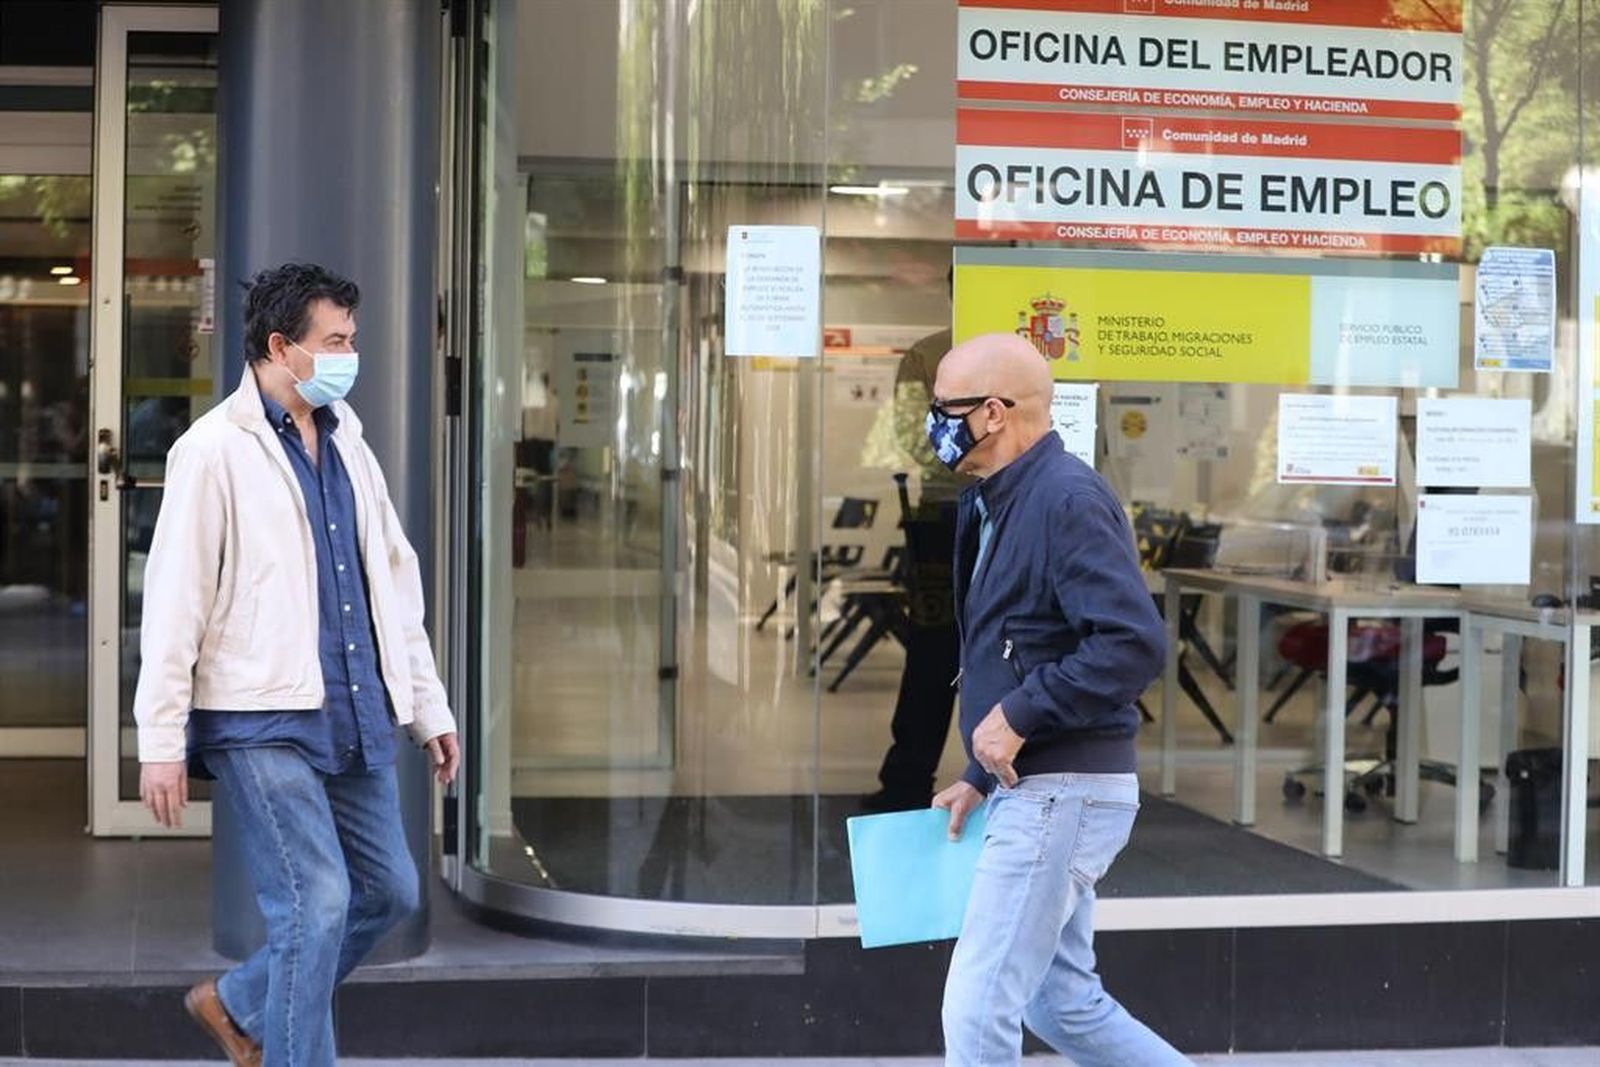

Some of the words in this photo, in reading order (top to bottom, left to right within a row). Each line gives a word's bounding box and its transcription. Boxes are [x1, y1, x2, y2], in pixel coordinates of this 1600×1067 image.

[1243, 0, 1260, 9] de
[1263, 0, 1308, 12] Madrid
[969, 29, 1126, 66] OFICINA
[1139, 37, 1211, 70] DEL
[1224, 41, 1453, 83] EMPLEADOR
[1059, 88, 1140, 104] CONSEJERÍA
[1143, 92, 1160, 104] DE
[1164, 93, 1235, 109] ECONOMÍA,
[1239, 96, 1291, 110] EMPLEO
[1294, 99, 1304, 110] Y
[1305, 99, 1369, 113] HACIENDA
[1162, 129, 1238, 143] Comunidad
[1241, 133, 1258, 144] de
[1262, 134, 1308, 146] Madrid
[967, 163, 1166, 208] OFICINA
[1182, 171, 1243, 211] DE
[1261, 174, 1451, 219] EMPLEO
[1057, 225, 1138, 241] CONSEJERÍA
[1141, 229, 1159, 241] DE
[1236, 232, 1289, 245] EMPLEO
[1291, 234, 1301, 245] Y
[1302, 234, 1367, 248] HACIENDA
[1097, 315, 1165, 329] MINISTERIO
[1097, 329, 1113, 341] DE
[1171, 331, 1253, 345] MIGRACIONES
[1354, 335, 1390, 345] EMPLEO
[1392, 335, 1429, 346] ESTATAL
[1097, 344, 1105, 356] Y
[1108, 344, 1177, 358] SEGURIDAD
[1180, 346, 1223, 358] SOCIAL
